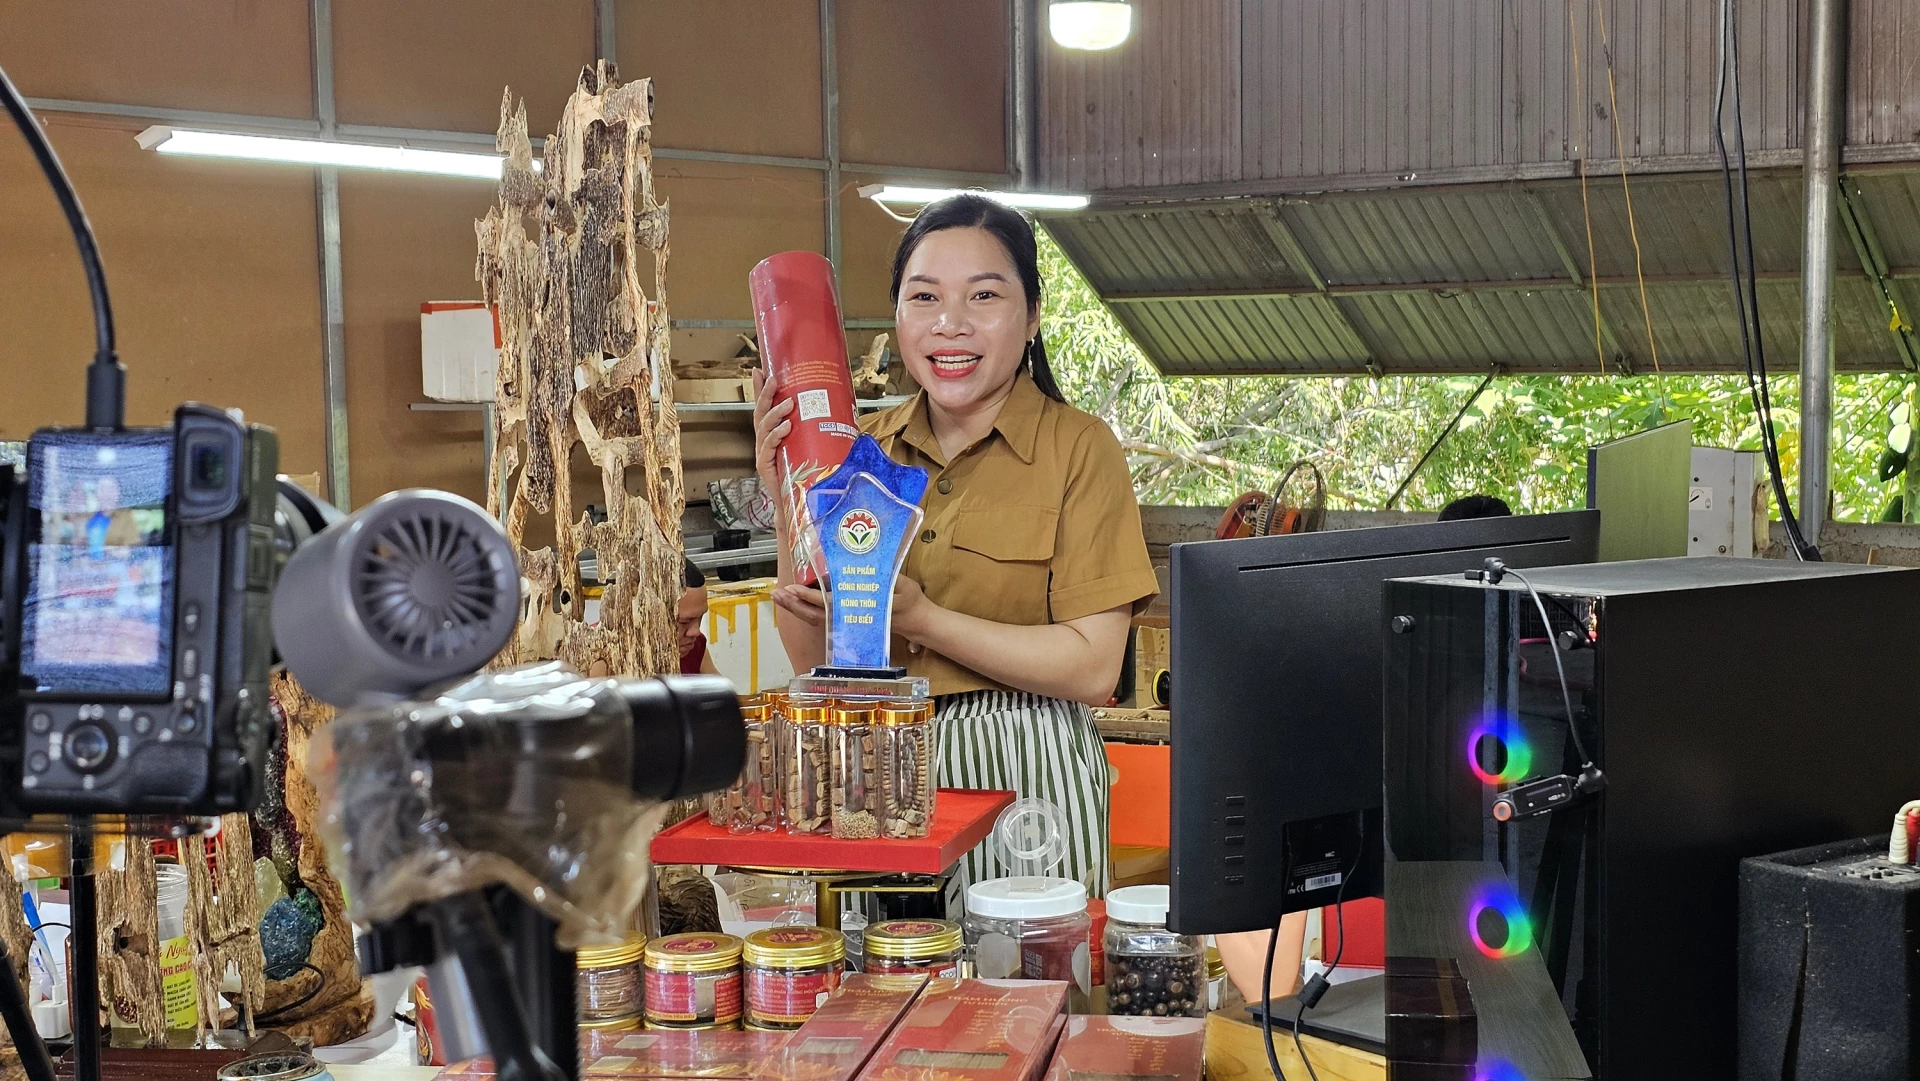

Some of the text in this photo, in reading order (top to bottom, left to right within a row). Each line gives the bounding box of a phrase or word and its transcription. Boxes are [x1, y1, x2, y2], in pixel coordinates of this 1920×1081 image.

[856, 564, 876, 576] PHẨM
[837, 581, 880, 593] CÔNG NGHIỆP
[840, 598, 877, 608] NÔNG THÔN
[844, 613, 873, 624] TIÊU BIỂU
